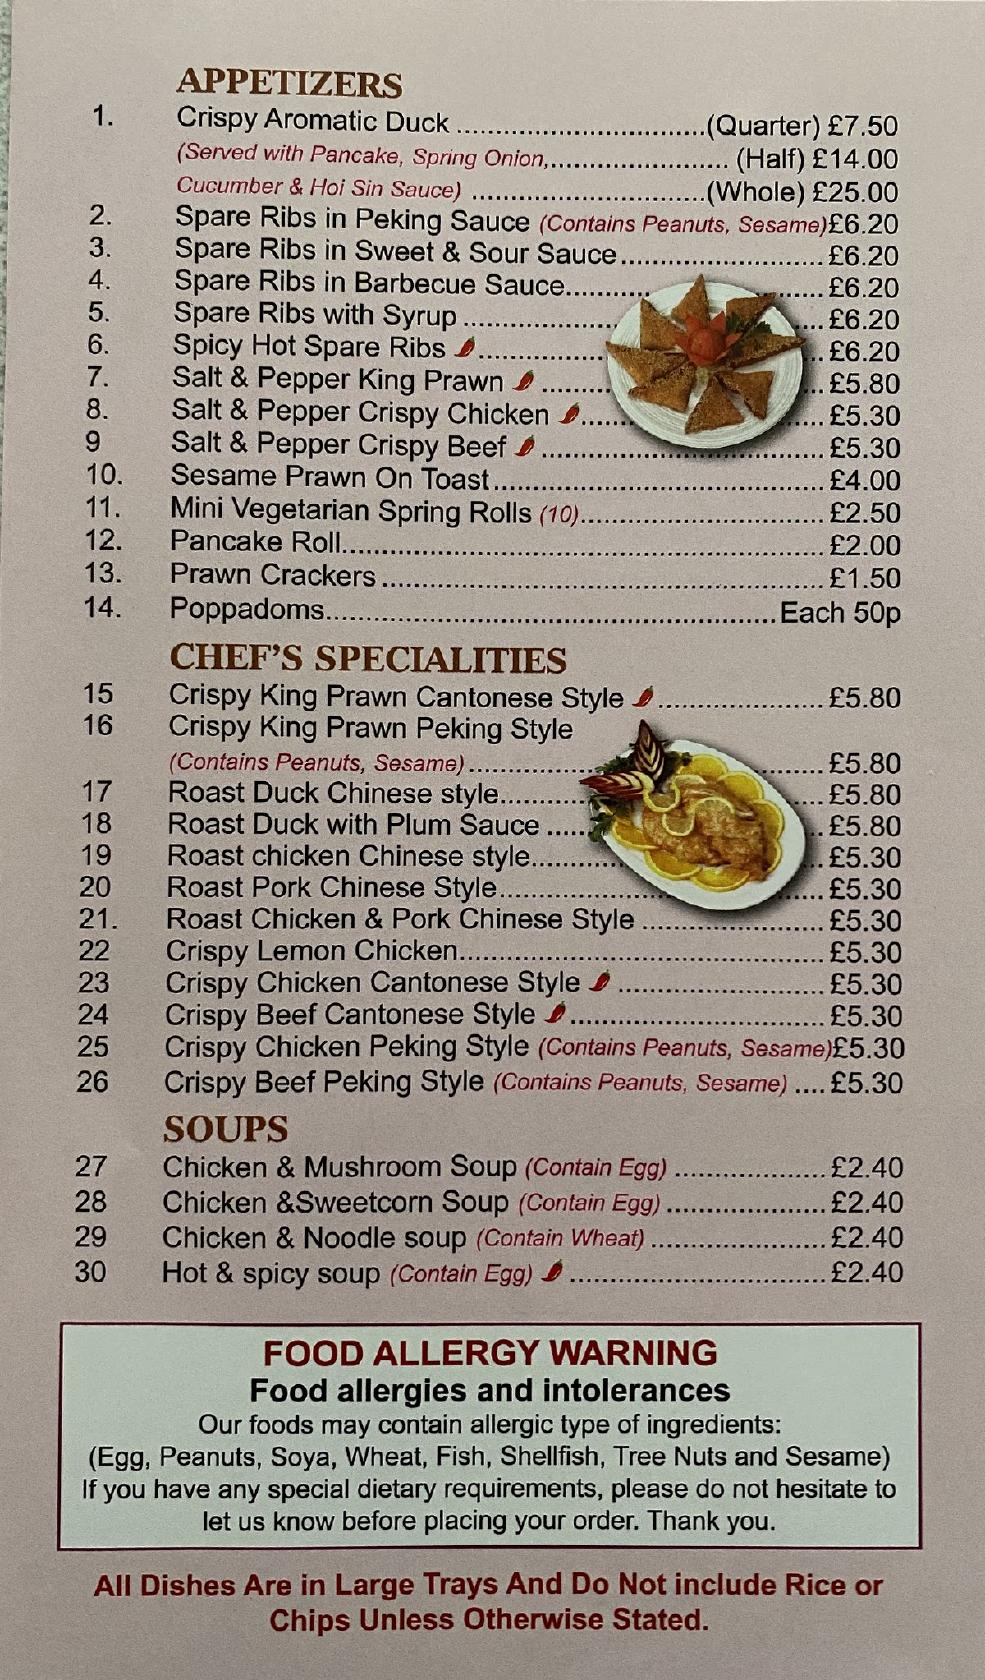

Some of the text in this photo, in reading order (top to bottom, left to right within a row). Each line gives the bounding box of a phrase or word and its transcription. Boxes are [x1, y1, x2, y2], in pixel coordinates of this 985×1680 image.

[176, 68, 402, 99] APPETIZERS
[94, 104, 112, 126] 1.
[177, 105, 449, 133] Crispy Aromatic Duck
[708, 114, 898, 141] (Quarter) £7.50
[178, 142, 258, 164] (Served
[264, 145, 303, 161] with
[310, 145, 403, 167] Pancake,
[413, 148, 477, 170] Spring
[737, 147, 898, 174] (Half) £14.00
[177, 176, 461, 203] Cucumber & Hoi Sin Sauce)
[708, 181, 898, 208] (Whole) £25.00
[89, 301, 109, 322] 5.
[174, 301, 456, 332] Spare Ribs with Syrup
[829, 308, 899, 330] £6.20
[88, 366, 108, 387] 7.
[173, 366, 503, 396] Salt & Pepper King Prawn
[830, 372, 900, 394] £5.80
[86, 430, 100, 452] 9
[172, 430, 507, 462] Salt & Pepper Crispy Beef
[830, 437, 900, 458] £5.30
[88, 463, 122, 485] 10.
[172, 463, 489, 490] Sesame Prawn On Toast
[830, 469, 900, 491] £4.00
[85, 561, 121, 583] 13.
[172, 562, 376, 587] Prawn Crackers
[830, 567, 901, 588] £1.50
[85, 596, 121, 618] 14.
[781, 601, 901, 628] Each 50p
[315, 645, 566, 674] SPECIALITIES
[84, 714, 112, 735] 16
[169, 714, 573, 744] Crispy King Prawn Peking Style
[170, 752, 464, 776] (Contains Peanuts, Sesame)
[829, 752, 901, 774] £5.80
[82, 812, 111, 834] 18
[169, 812, 539, 835] Roast Duck with Plum Sauce
[829, 815, 901, 836] £5.80
[79, 939, 109, 961] 22
[167, 939, 456, 967] Crispy Lemon Chicken
[830, 941, 901, 964] £5.30
[78, 1003, 108, 1025] 24
[166, 1002, 535, 1031] Crispy Beef Cantonese Style
[831, 1005, 902, 1027] £5.30
[164, 1115, 287, 1143] SOUPS
[76, 1155, 107, 1177] 27
[163, 1154, 666, 1182] Chicken & Mushroom Soup (Contain Egg)
[832, 1156, 903, 1178] £2.40
[75, 1226, 106, 1247] 29
[163, 1226, 644, 1254] Chicken & Noodle soup (Contain Wheat)
[832, 1226, 903, 1248] £2.40
[264, 1339, 717, 1366] FOOD ALLERGY WARNING
[251, 1378, 730, 1408] Food allergies and intolerances
[199, 1414, 780, 1439] Our foods may contain allergic type of ingredients:
[89, 1445, 890, 1472] (Egg, Peanuts, Soya, Wheat, Fish, Shellfish, Tree Nuts and Sesame)
[204, 1509, 775, 1535] let us know before placing your order. Thank you.
[94, 1572, 884, 1600] All Dishes Are in Large Trays And Do Not include Rice or
[270, 1607, 708, 1636] Chips Unless Otherwise Stated.
